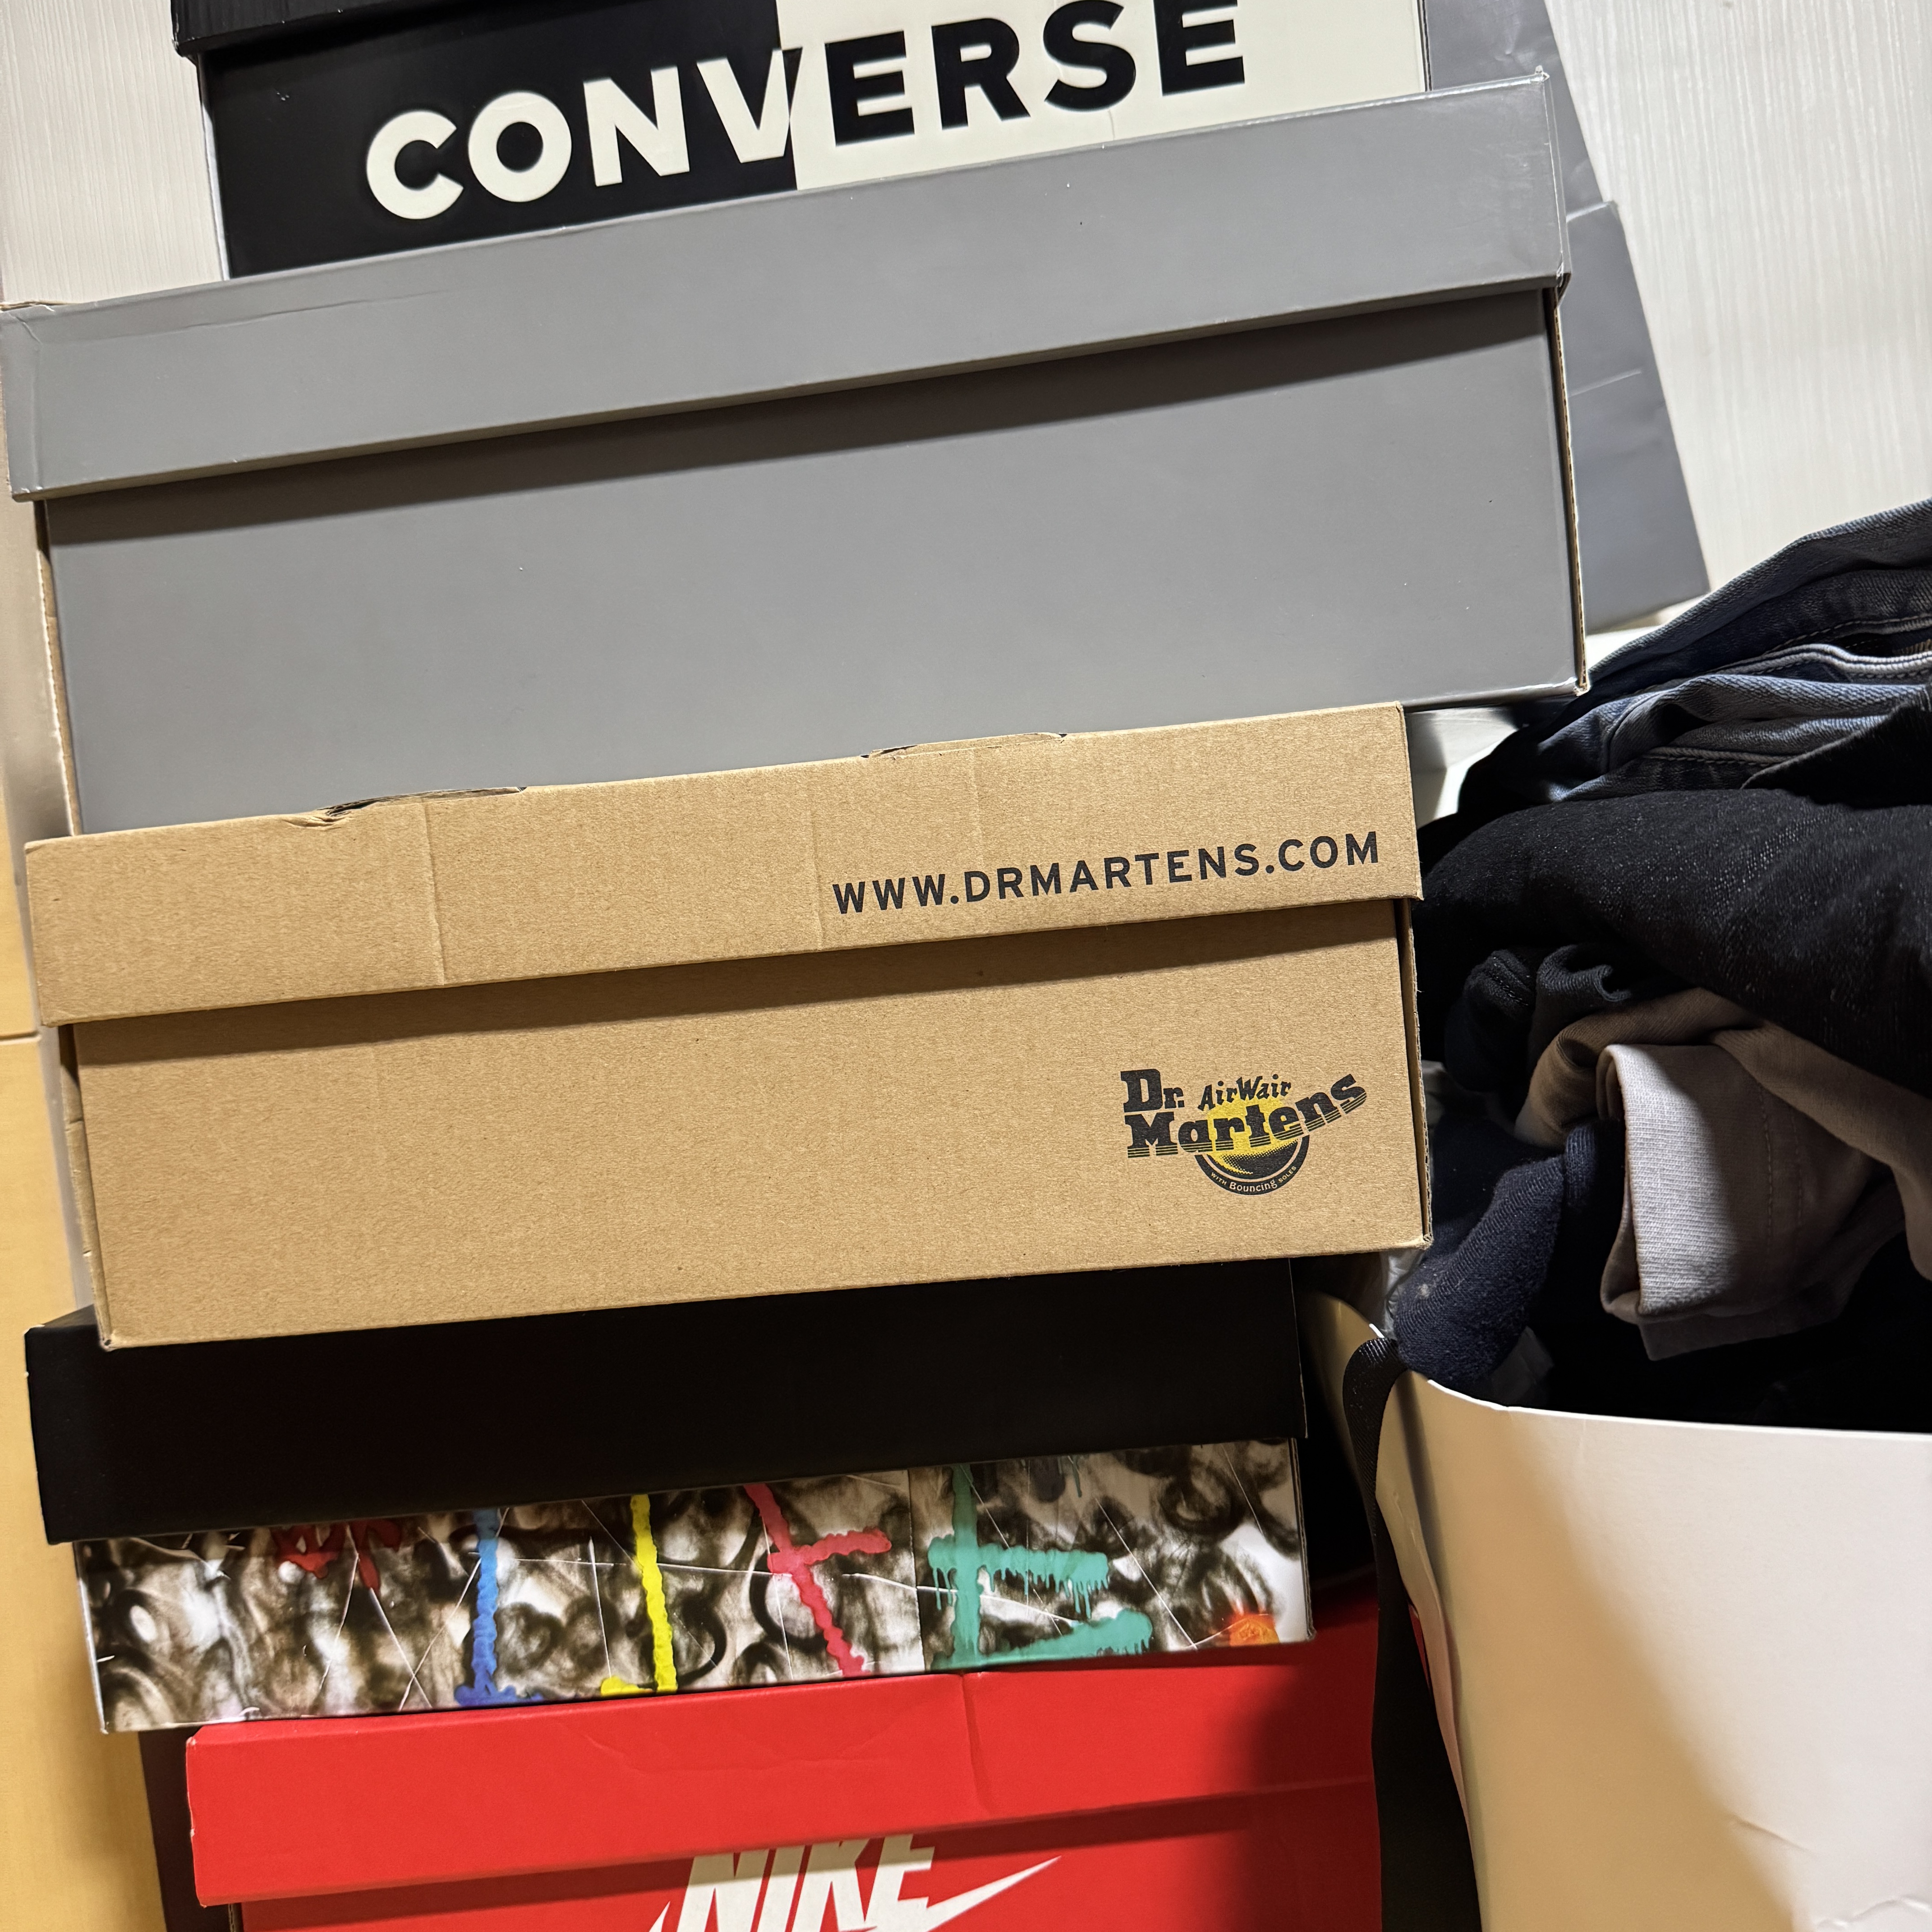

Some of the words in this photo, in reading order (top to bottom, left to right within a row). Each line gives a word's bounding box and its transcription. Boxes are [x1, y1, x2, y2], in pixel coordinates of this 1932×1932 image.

[367, 0, 1245, 220] CONVERSE
[833, 832, 1379, 914] WWW.DRMARTENS.COM
[1120, 1068, 1185, 1113] Dr.
[1125, 1073, 1367, 1158] Martens
[1198, 1074, 1292, 1112] AirWair
[1211, 1172, 1227, 1186] WITH
[1229, 1179, 1277, 1192] Bouncing
[1278, 1166, 1297, 1183] SOLES
[676, 1833, 935, 1932] NIKE
